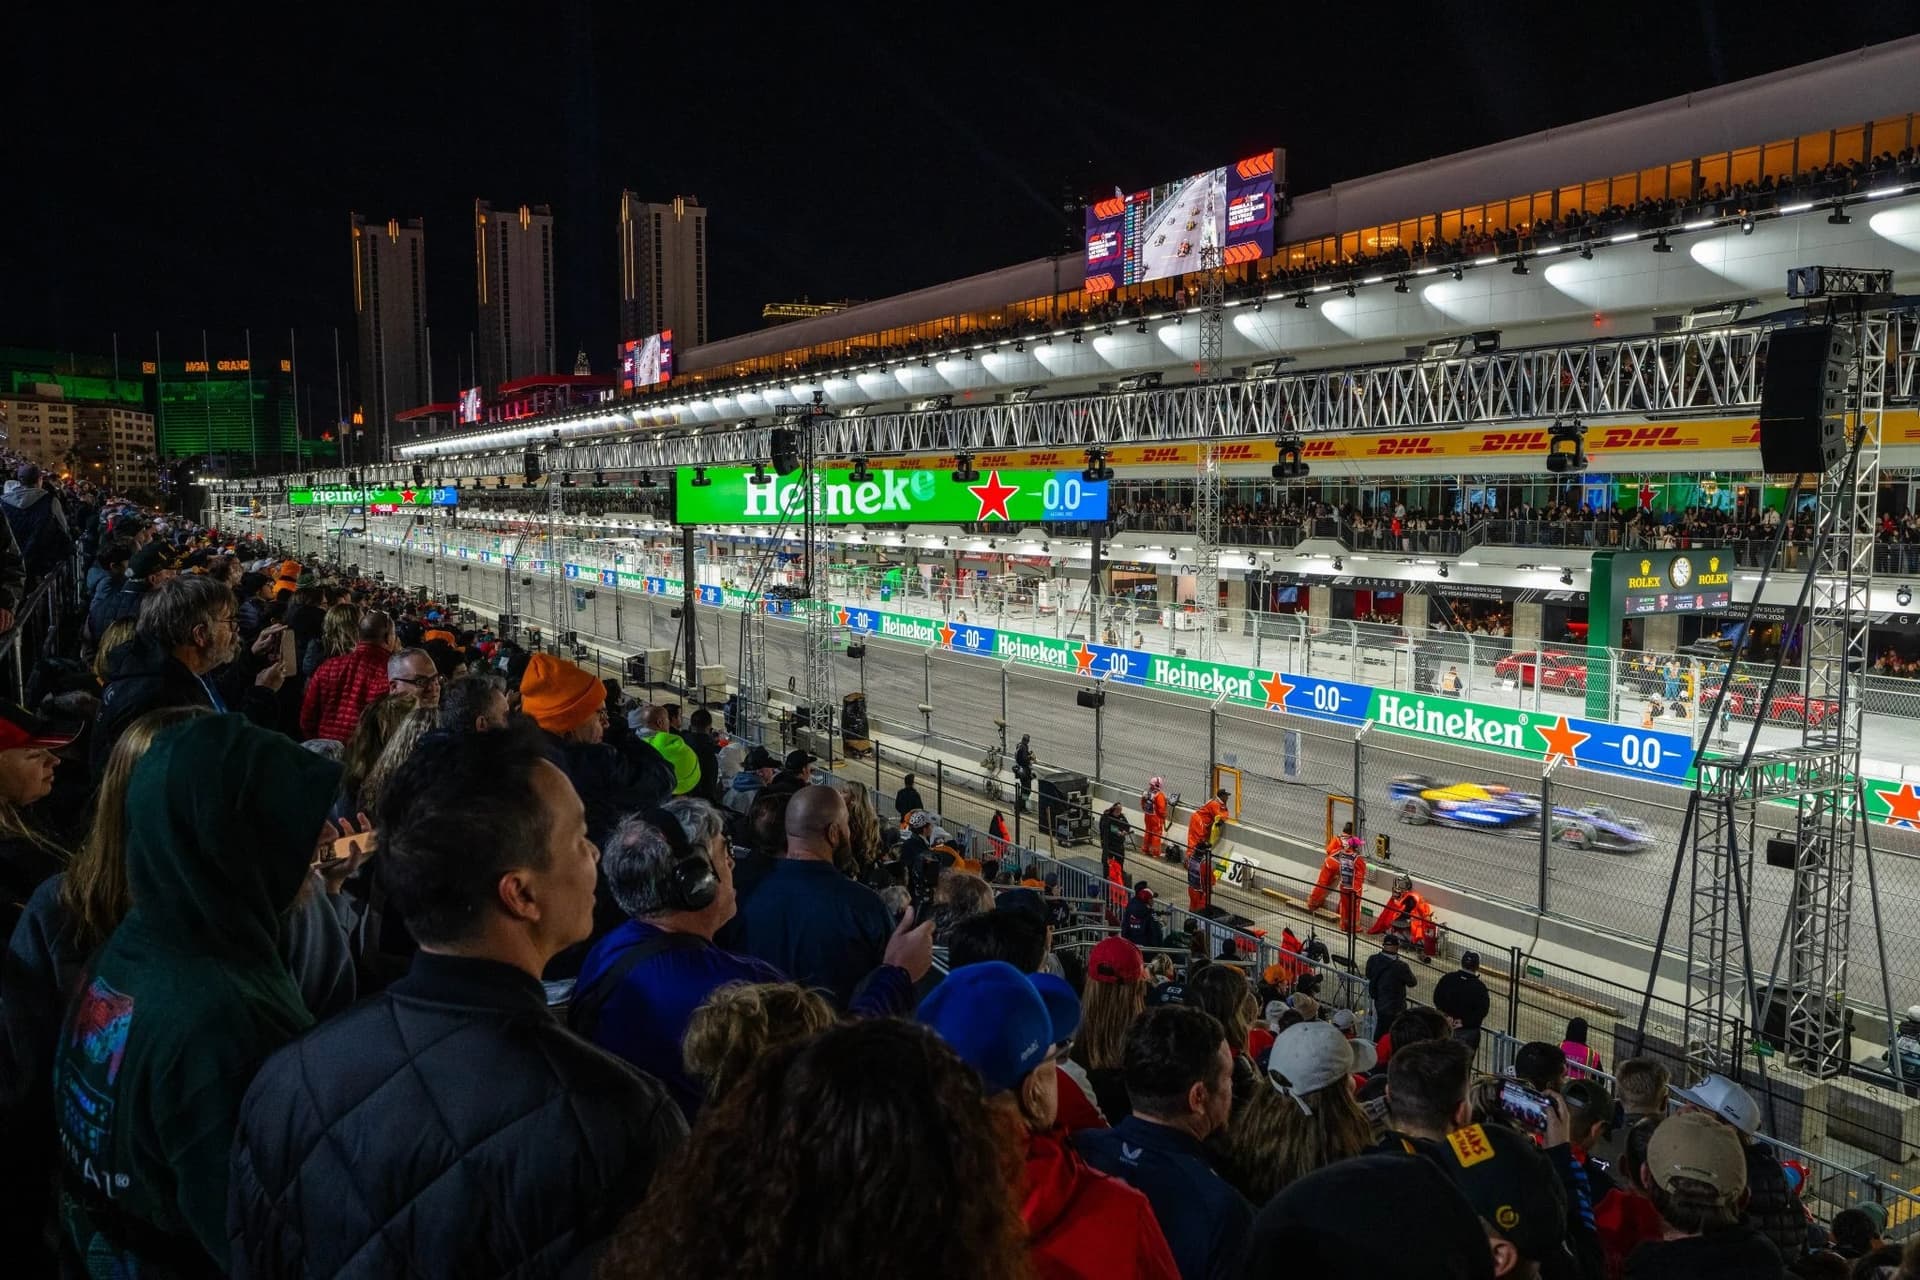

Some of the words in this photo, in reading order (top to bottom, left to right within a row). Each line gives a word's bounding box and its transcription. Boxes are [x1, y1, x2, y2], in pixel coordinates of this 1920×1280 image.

[185, 361, 209, 372] MGM
[216, 360, 250, 371] GRAND
[1377, 438, 1433, 454] DHL
[1481, 433, 1547, 452] DHL
[1602, 427, 1681, 447] DHL
[1143, 448, 1178, 461] DHL
[1211, 445, 1252, 459] DHL
[1304, 441, 1336, 456] HL
[982, 456, 1007, 467] DHL
[1031, 453, 1057, 466] DHL
[1043, 478, 1081, 511] 0.0
[1356, 578, 1404, 588] GARAGE
[1628, 577, 1661, 588] ROLEX
[1698, 573, 1729, 585] ROLEX
[857, 611, 868, 629] 0.0
[882, 616, 935, 642] Heineken
[965, 630, 979, 649] 0.0
[998, 634, 1068, 666] Heineken
[1110, 651, 1128, 675] 0.0
[1155, 659, 1251, 698] Heineken
[1314, 684, 1340, 712] 0.0
[1377, 694, 1525, 750] Heineken
[1620, 733, 1661, 770] 0.0
